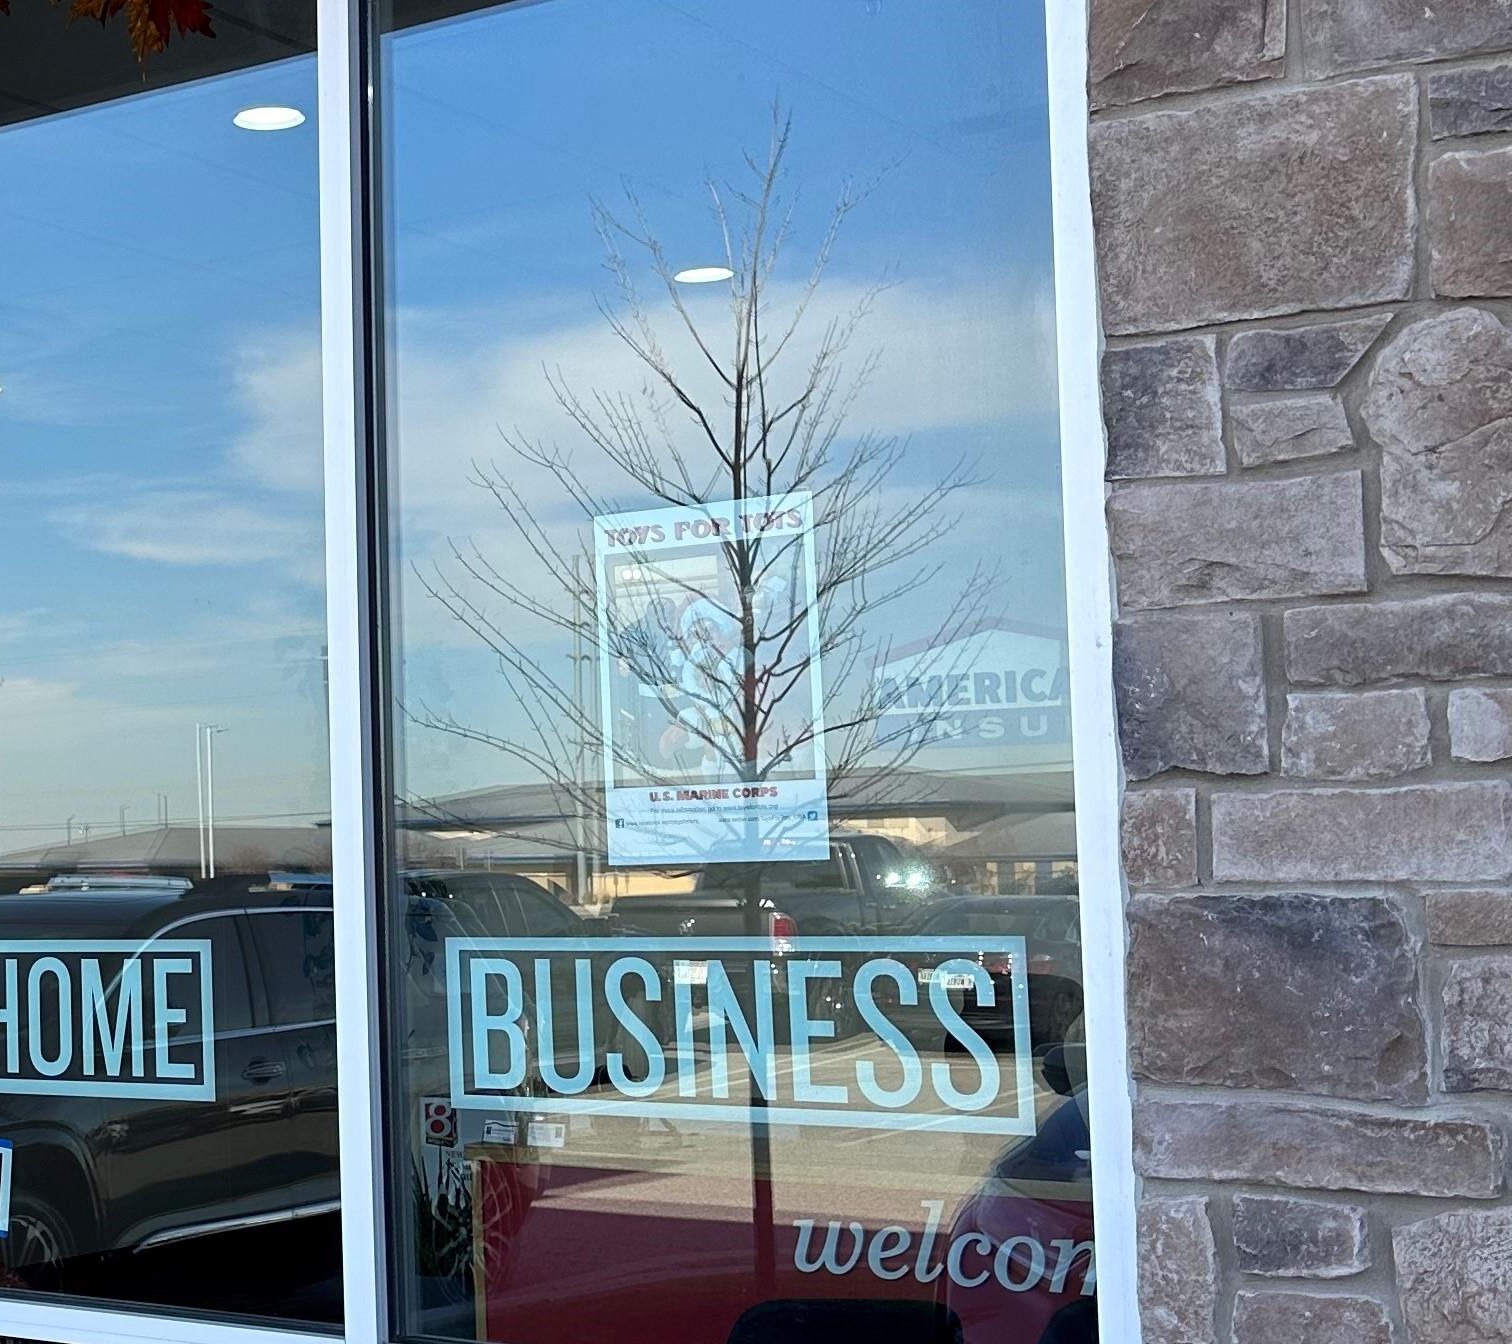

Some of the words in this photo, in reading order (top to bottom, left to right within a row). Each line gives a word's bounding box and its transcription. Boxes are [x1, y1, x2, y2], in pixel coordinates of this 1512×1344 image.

[604, 523, 666, 548] TOYS
[674, 517, 732, 541] FOR
[739, 509, 803, 534] TOTS
[649, 790, 674, 802] U.S.
[676, 788, 729, 801] MARINE
[732, 786, 778, 799] CORPS
[470, 956, 1001, 1111] BUSINESS
